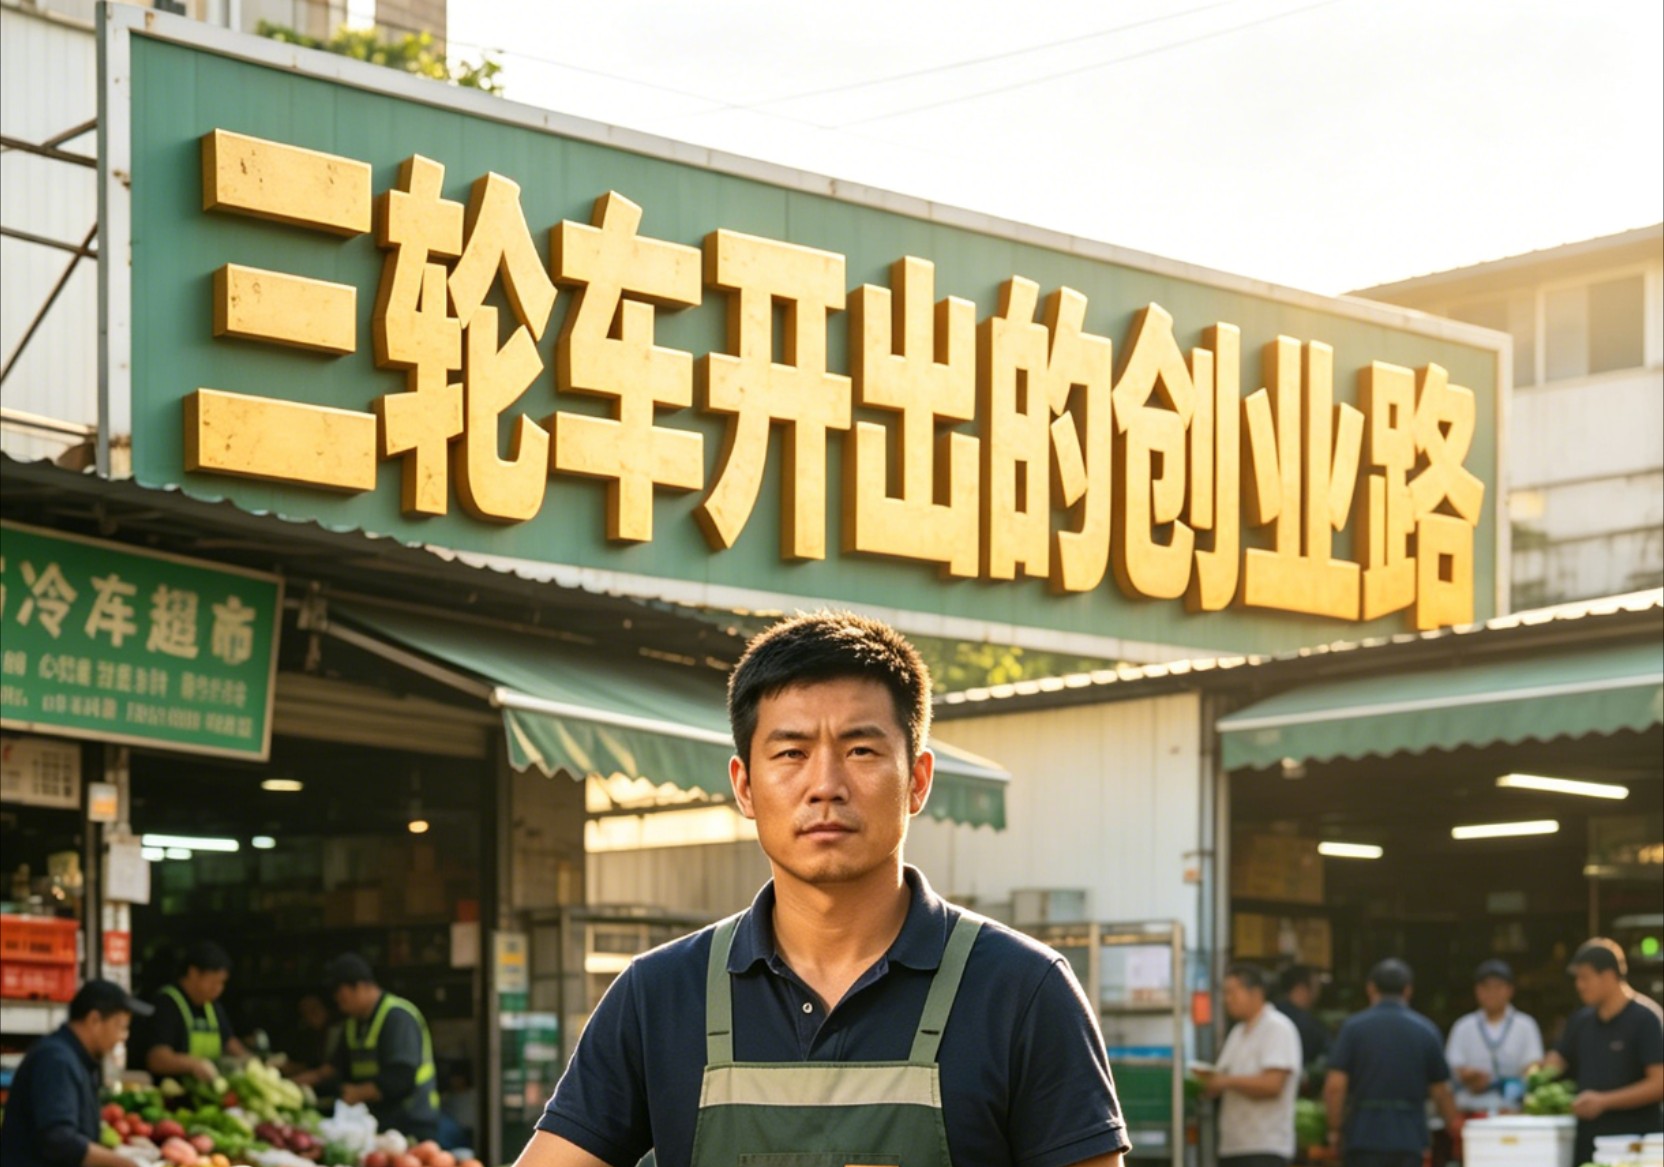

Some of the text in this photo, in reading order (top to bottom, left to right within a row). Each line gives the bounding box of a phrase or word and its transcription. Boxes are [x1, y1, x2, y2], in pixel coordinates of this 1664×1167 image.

[184, 128, 1484, 631] 三轮车开出的创业路
